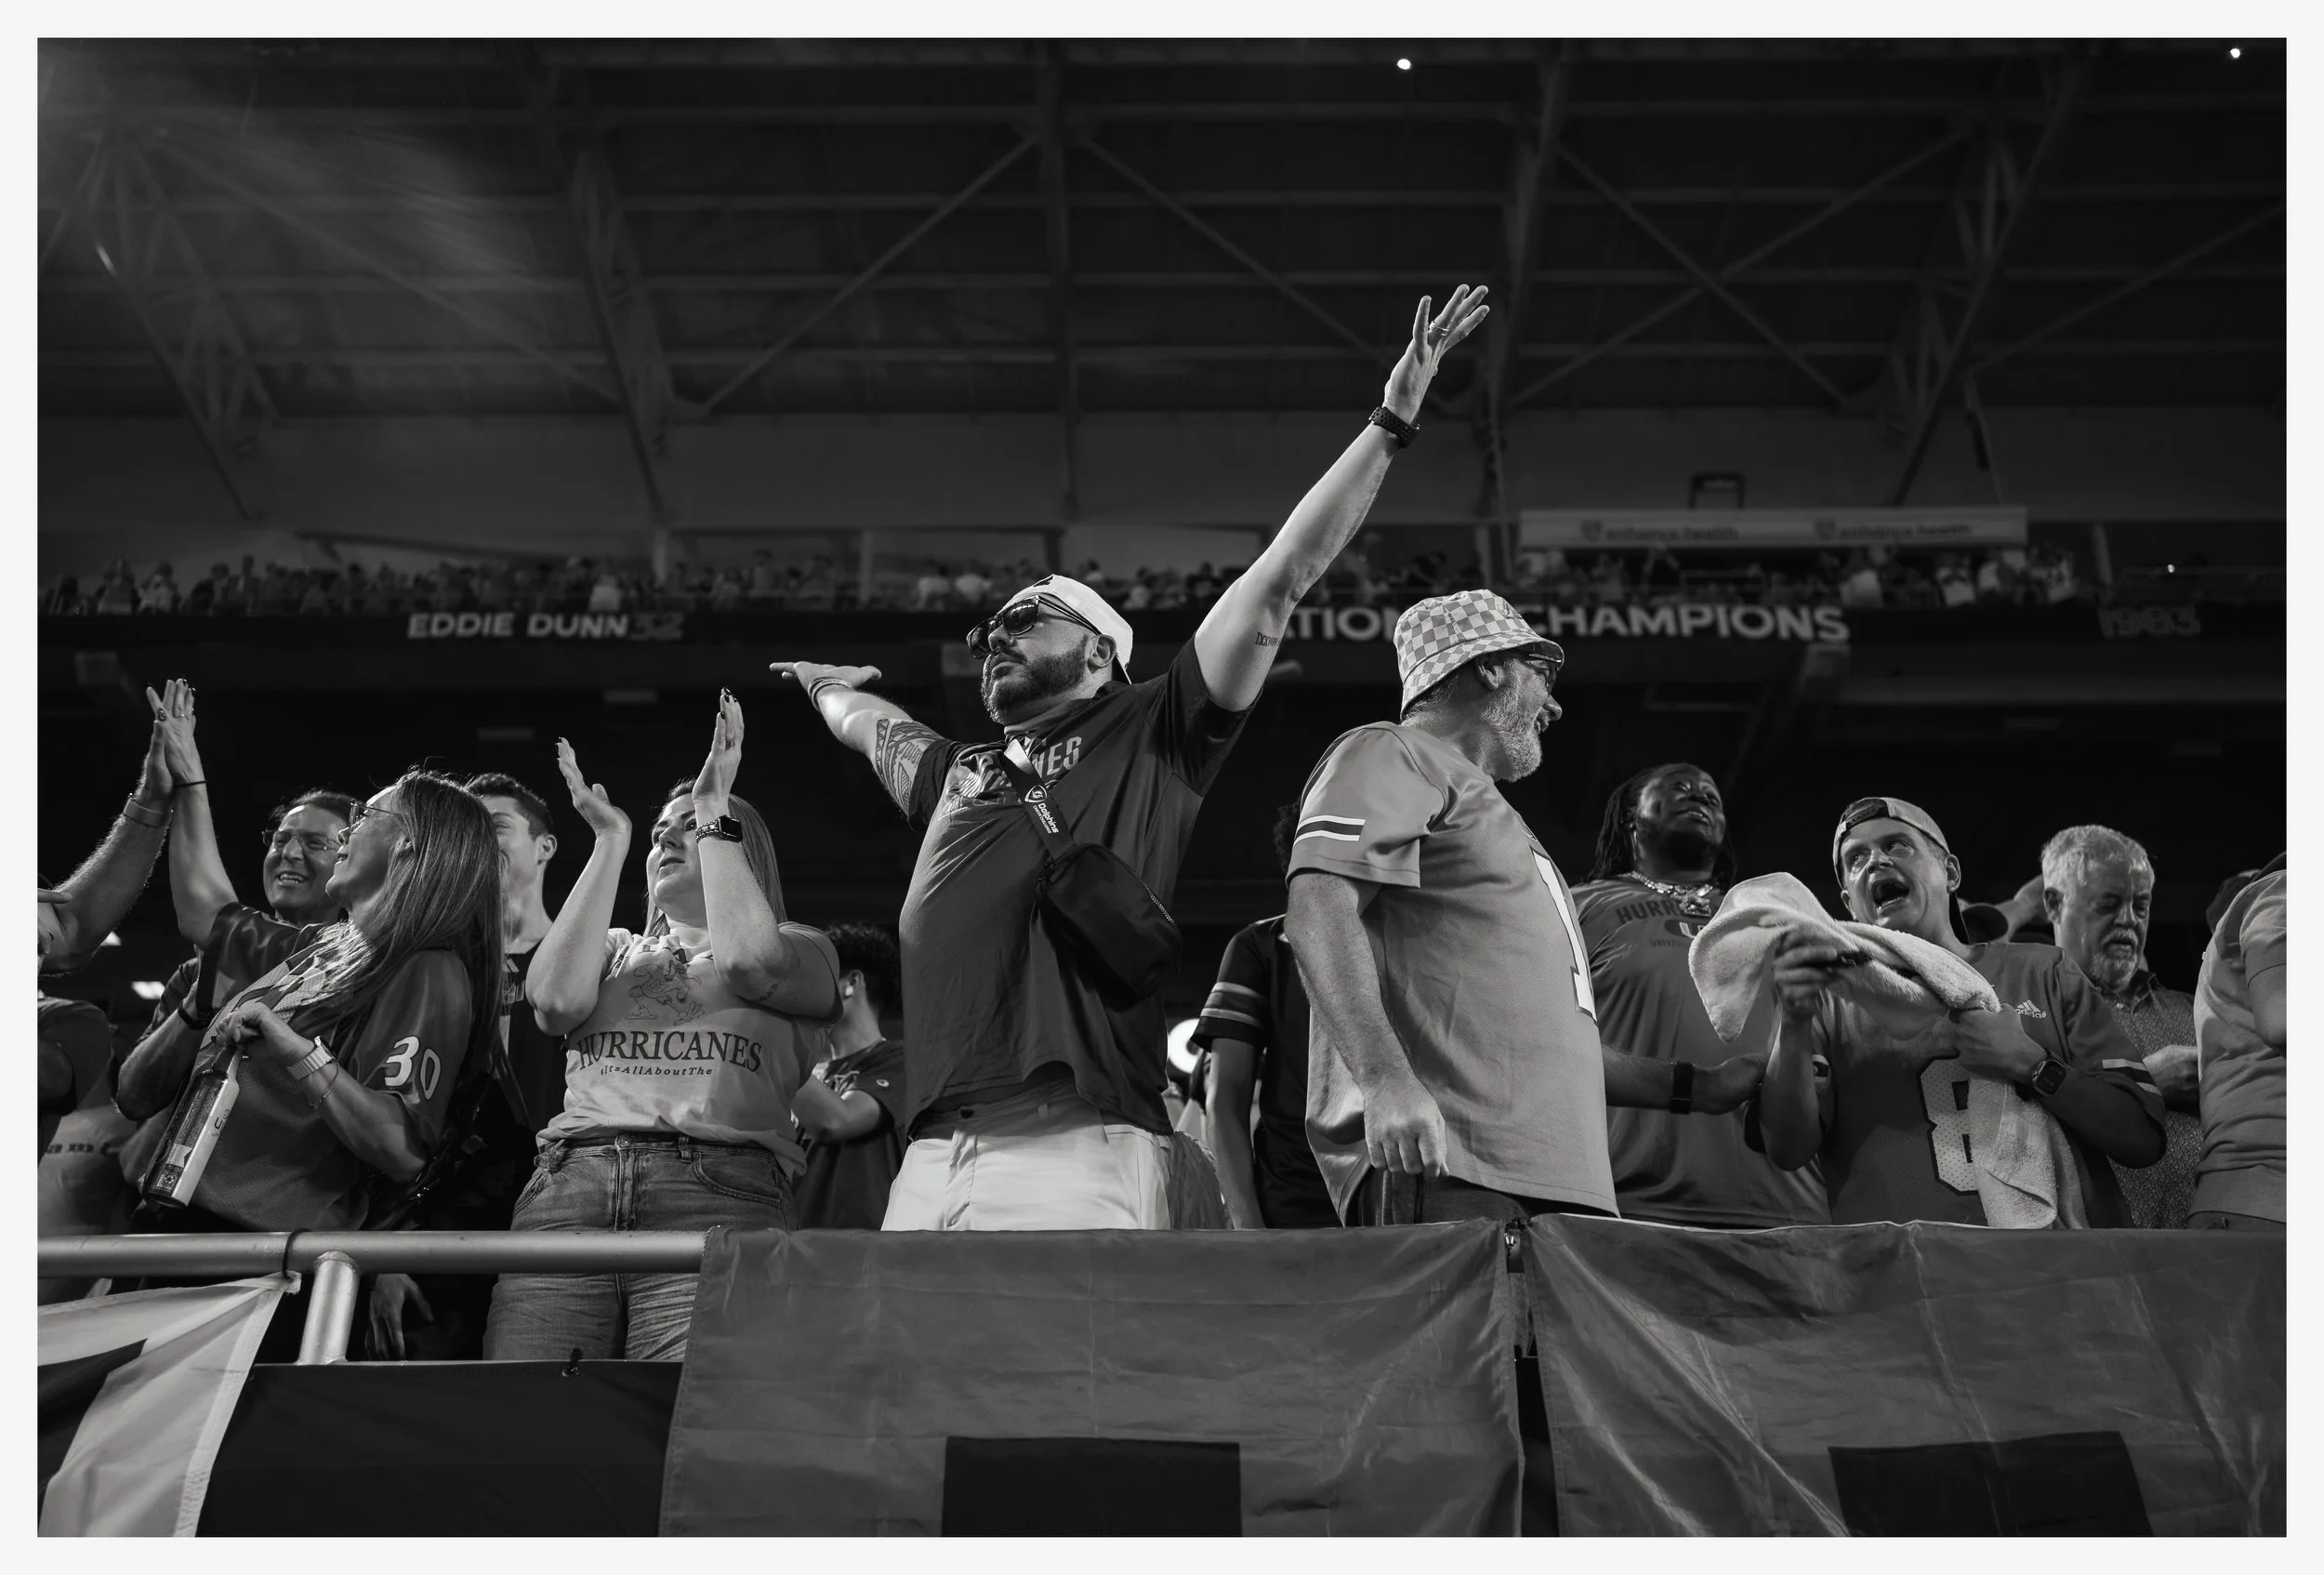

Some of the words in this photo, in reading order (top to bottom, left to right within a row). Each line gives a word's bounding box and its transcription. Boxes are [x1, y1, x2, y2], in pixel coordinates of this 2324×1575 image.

[407, 612, 516, 640] EDDIE
[526, 612, 628, 639] DUNN
[1037, 802, 1060, 833] Dolphins
[2014, 1008, 2047, 1019] adidas
[577, 1030, 762, 1072] HURRICANES
[384, 1036, 442, 1101] 30
